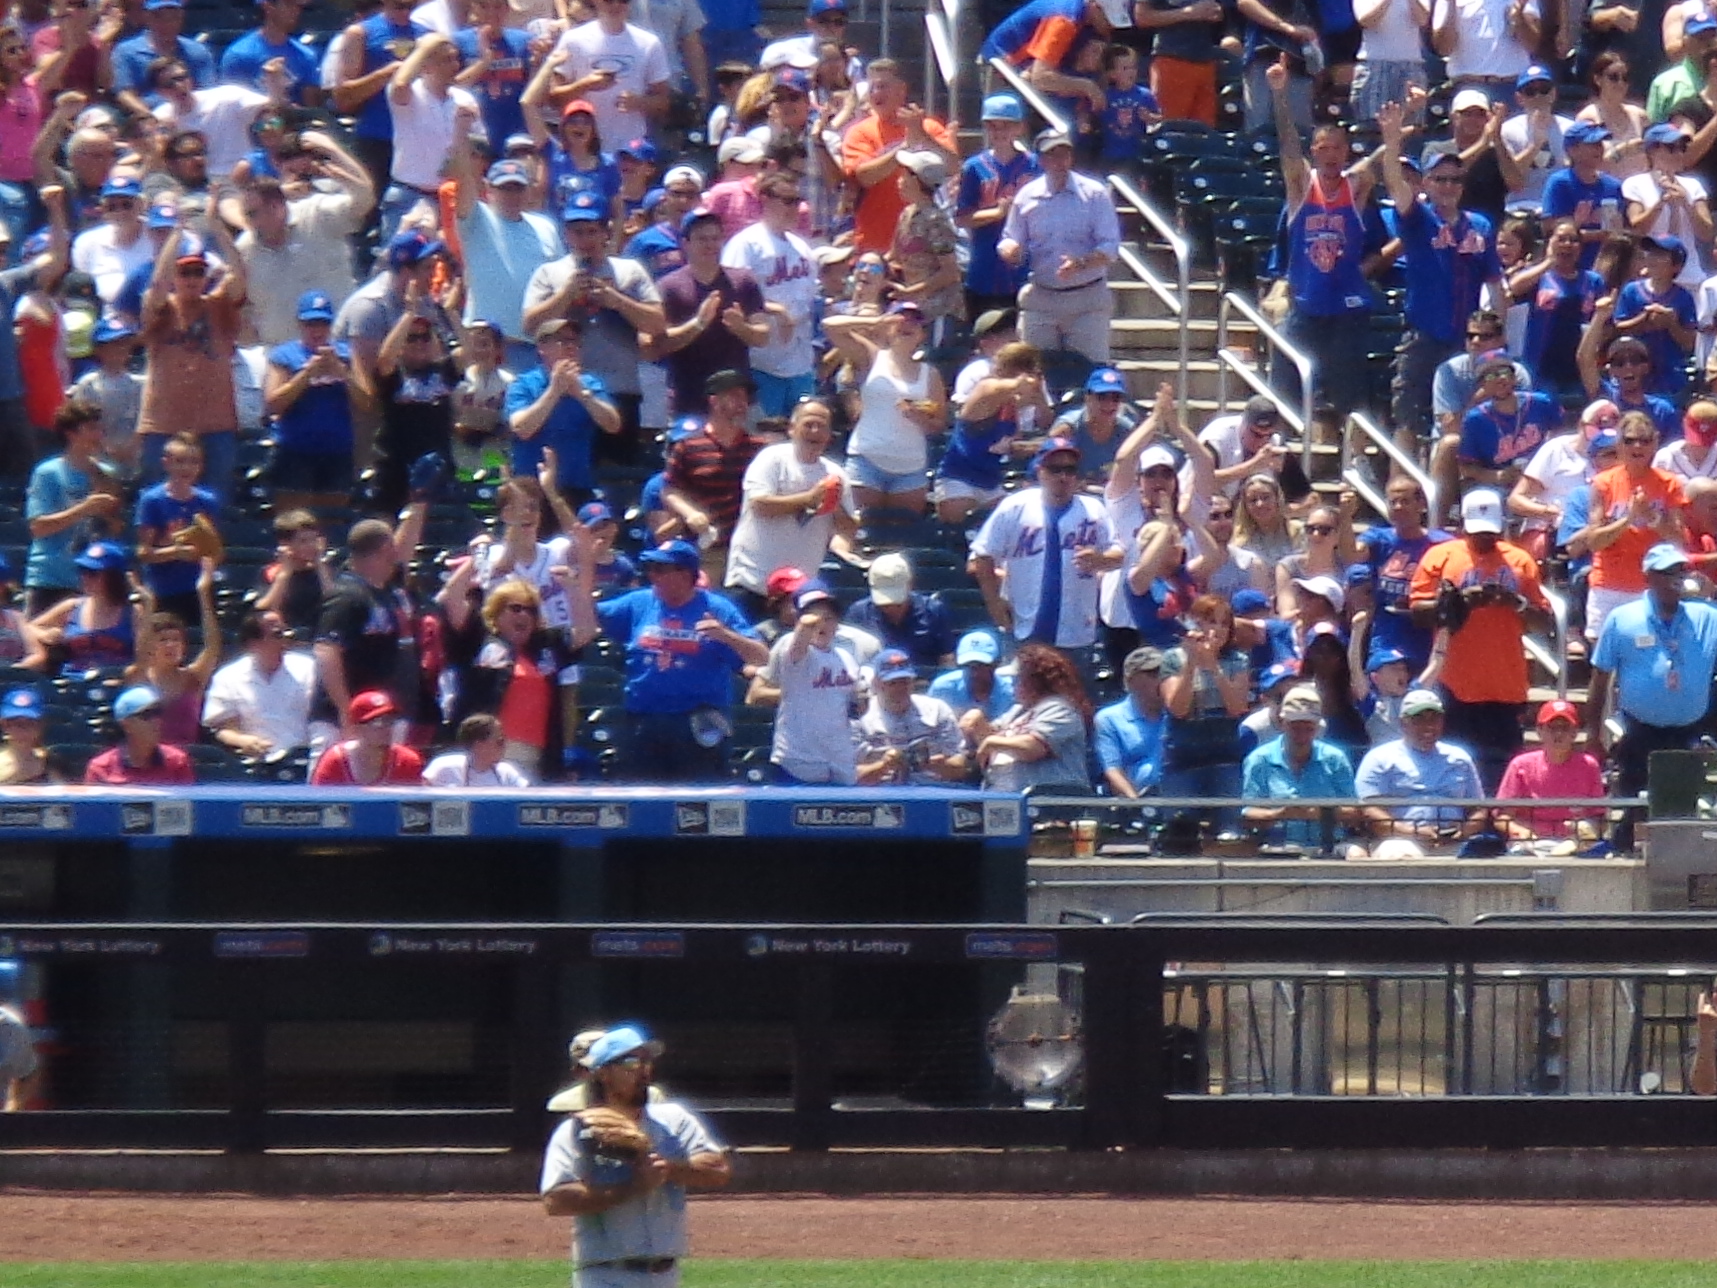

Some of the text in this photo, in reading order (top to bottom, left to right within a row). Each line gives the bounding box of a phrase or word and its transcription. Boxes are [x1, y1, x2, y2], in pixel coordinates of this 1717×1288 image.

[797, 809, 873, 825] MLB.com
[395, 940, 537, 955] New York Lottery
[773, 940, 910, 955] New York Lottery
